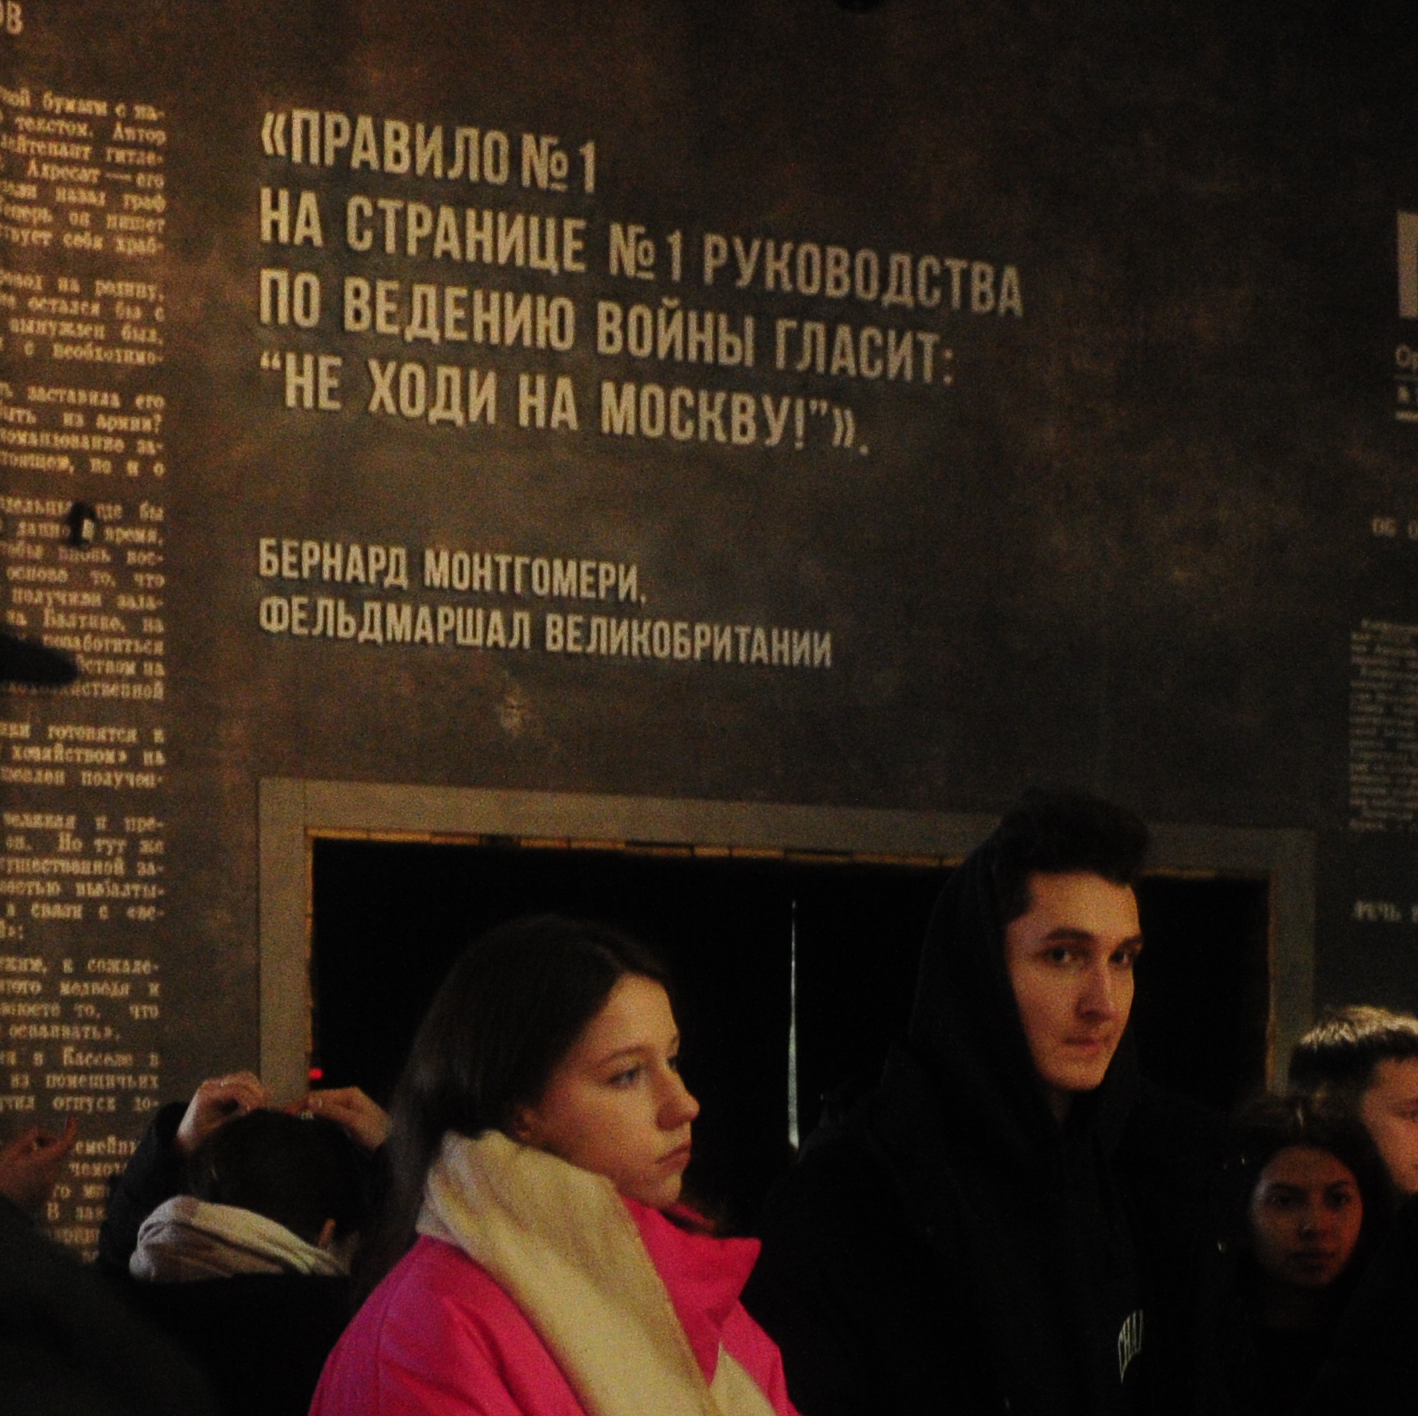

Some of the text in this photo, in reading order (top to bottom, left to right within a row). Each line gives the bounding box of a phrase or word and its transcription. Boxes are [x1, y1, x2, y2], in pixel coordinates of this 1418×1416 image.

[112, 122, 167, 147] Автор
[260, 106, 510, 186] «ПРАВИЛО
[259, 188, 324, 248] НА
[346, 193, 587, 276] СТРАНИЦЕ
[666, 228, 685, 284] 1
[704, 231, 1024, 318] РУКОВОДСТВА
[259, 267, 955, 387] ПО ВЕДЕНИЮ ВОЙНЫ ГЛАСИТ:
[259, 350, 343, 411] “НЕ
[368, 359, 498, 427] ХОДИ
[519, 375, 578, 432] НА
[259, 536, 648, 606] БЕРНАРД МОНТГОМЕРИ,
[259, 595, 833, 670] ФЕЛЬДМАРШАЛ ВЕЛИКОБРИТАНИИ
